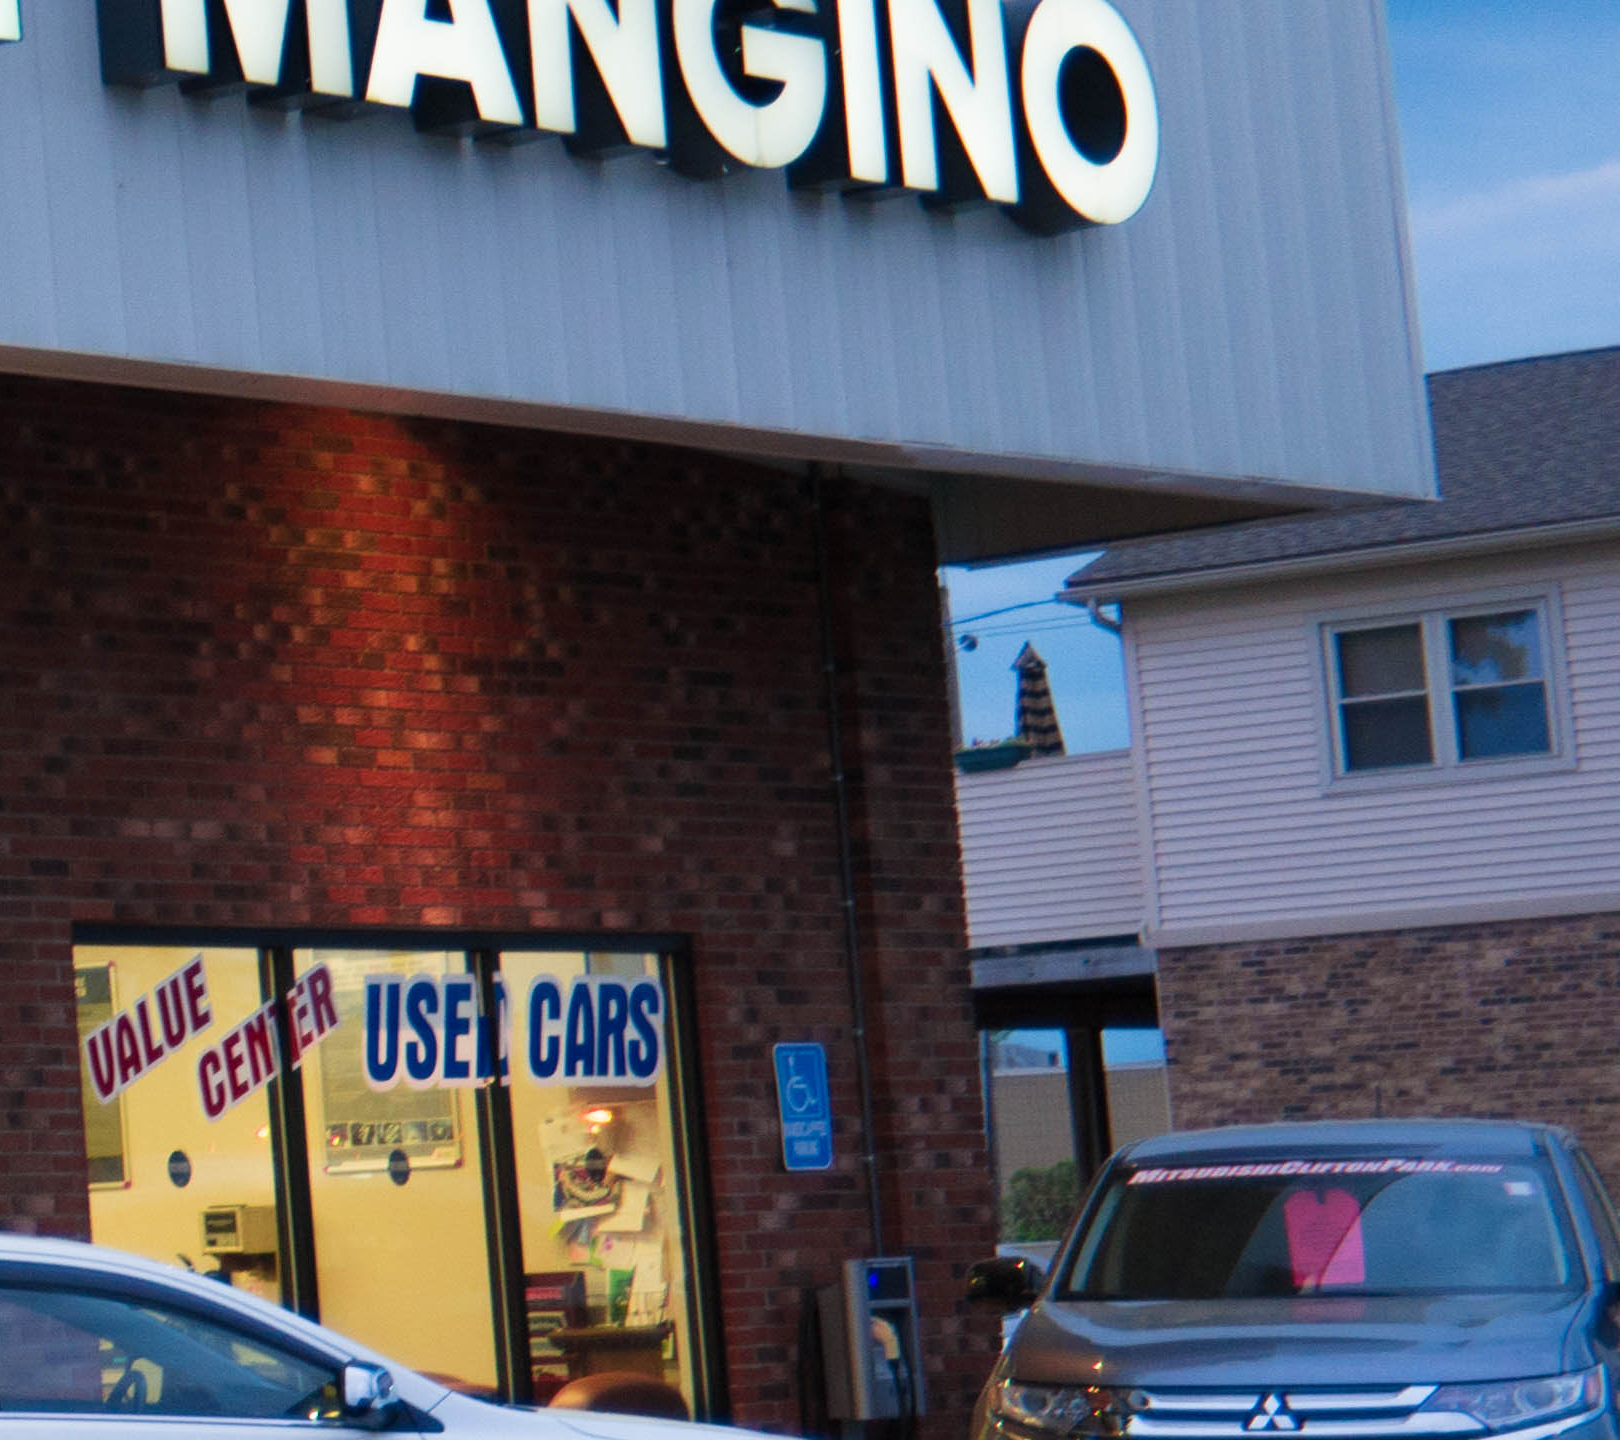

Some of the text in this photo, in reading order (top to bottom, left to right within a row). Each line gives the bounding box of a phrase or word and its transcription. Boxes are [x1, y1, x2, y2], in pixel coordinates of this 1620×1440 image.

[86, 956, 212, 1100] VALUE
[195, 962, 340, 1121] CENTER
[365, 979, 661, 1084] USED CARS
